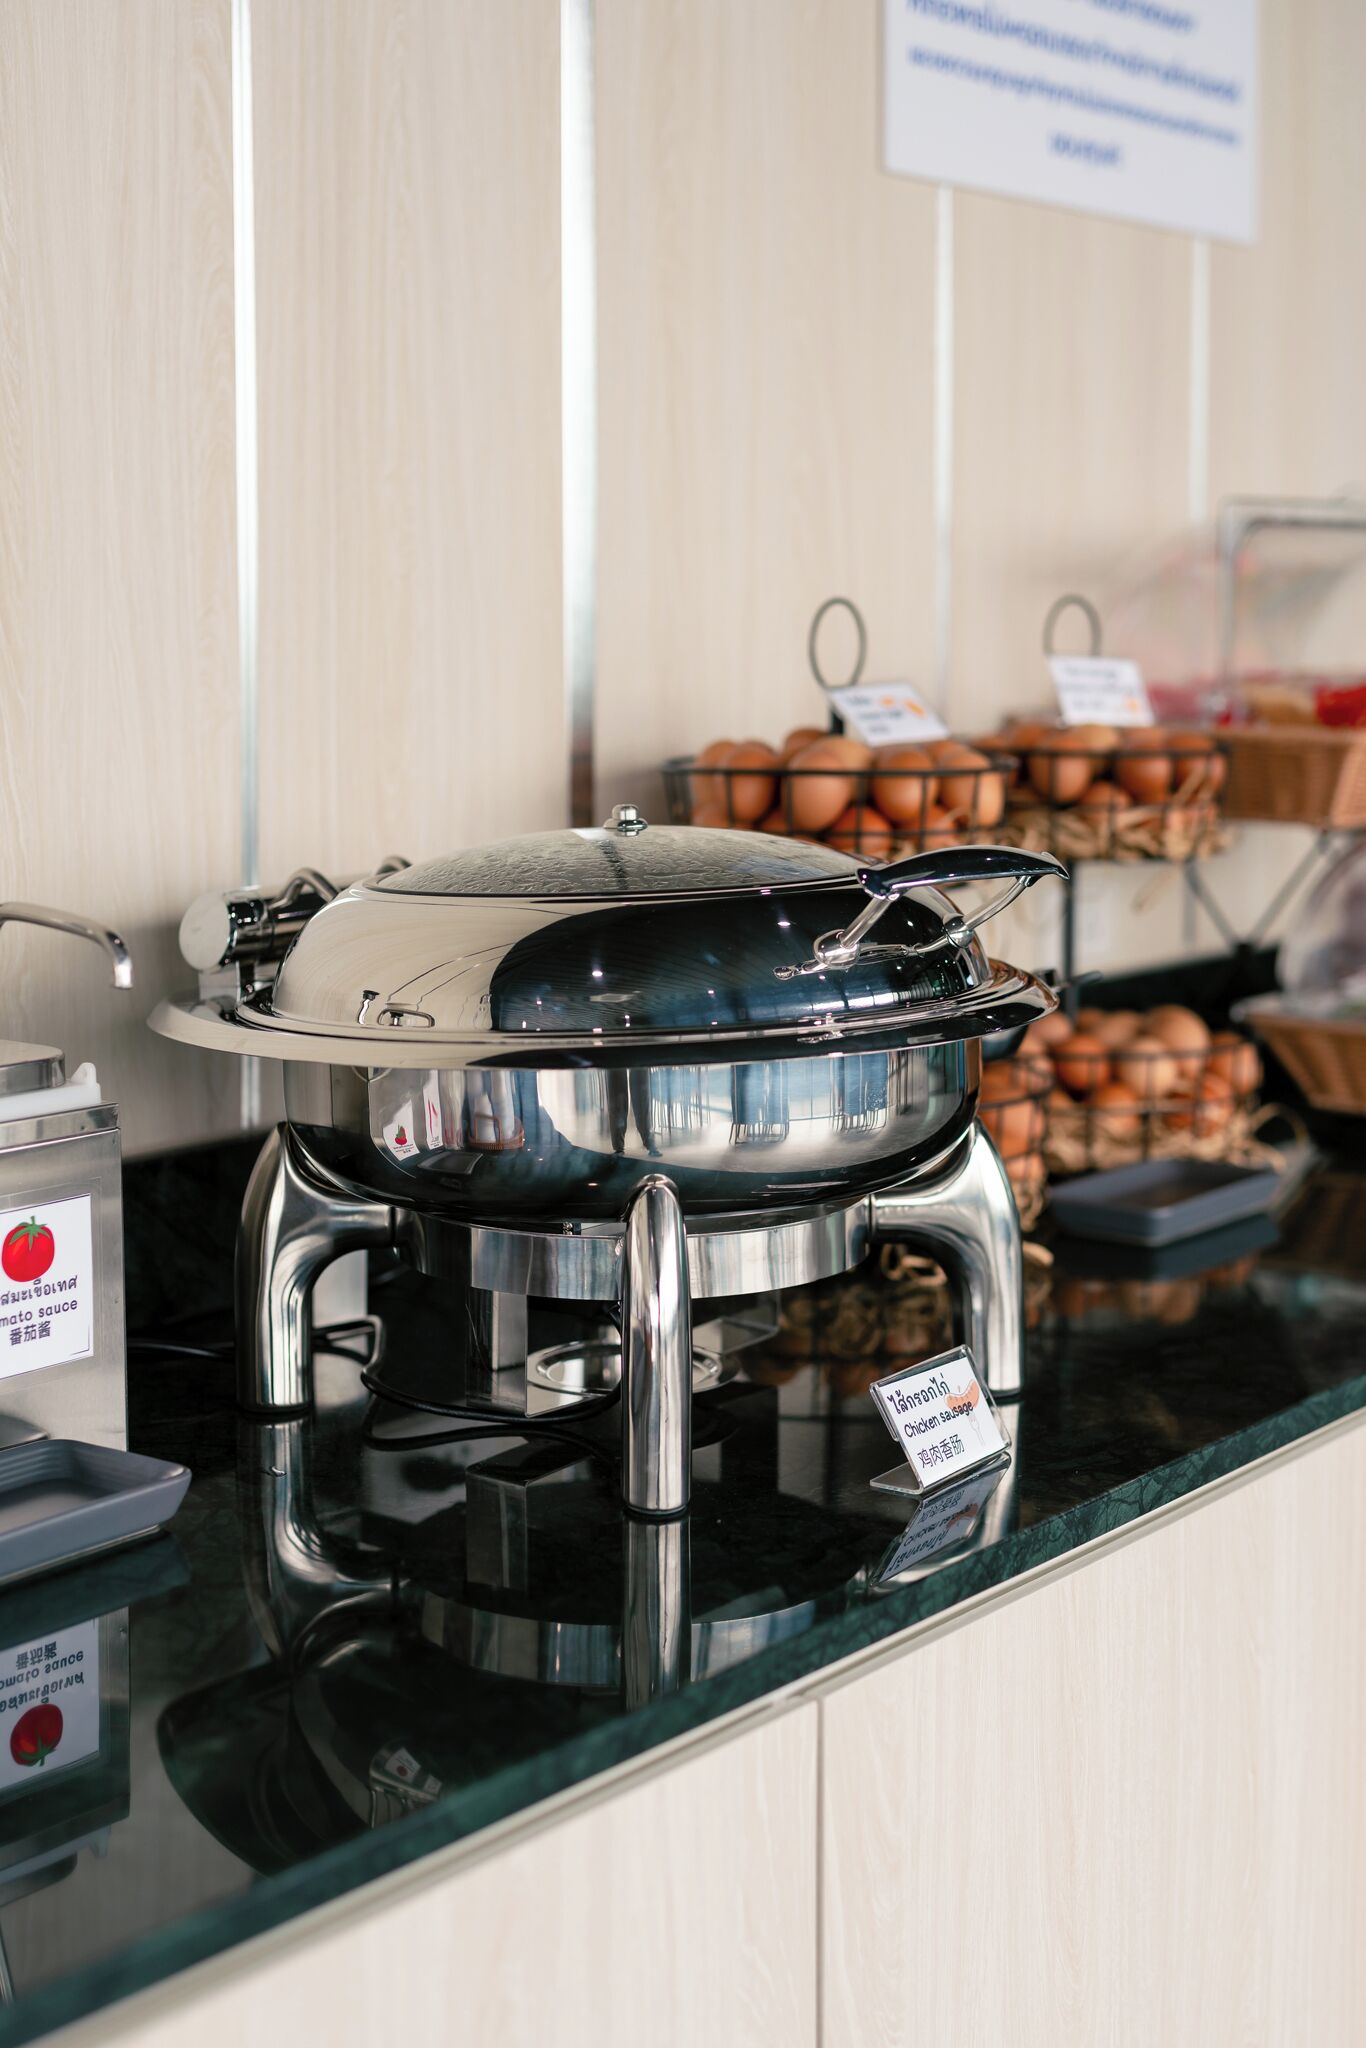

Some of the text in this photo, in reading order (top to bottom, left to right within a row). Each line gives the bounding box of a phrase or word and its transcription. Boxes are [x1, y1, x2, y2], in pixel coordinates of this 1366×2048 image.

[38, 1299, 78, 1318] sauce
[10, 1320, 51, 1346] 番茄酱
[887, 1373, 950, 1415] ไส้กรอกไก่
[904, 1401, 974, 1438] Chicken sausage
[917, 1433, 965, 1469] 鸡肉香肠
